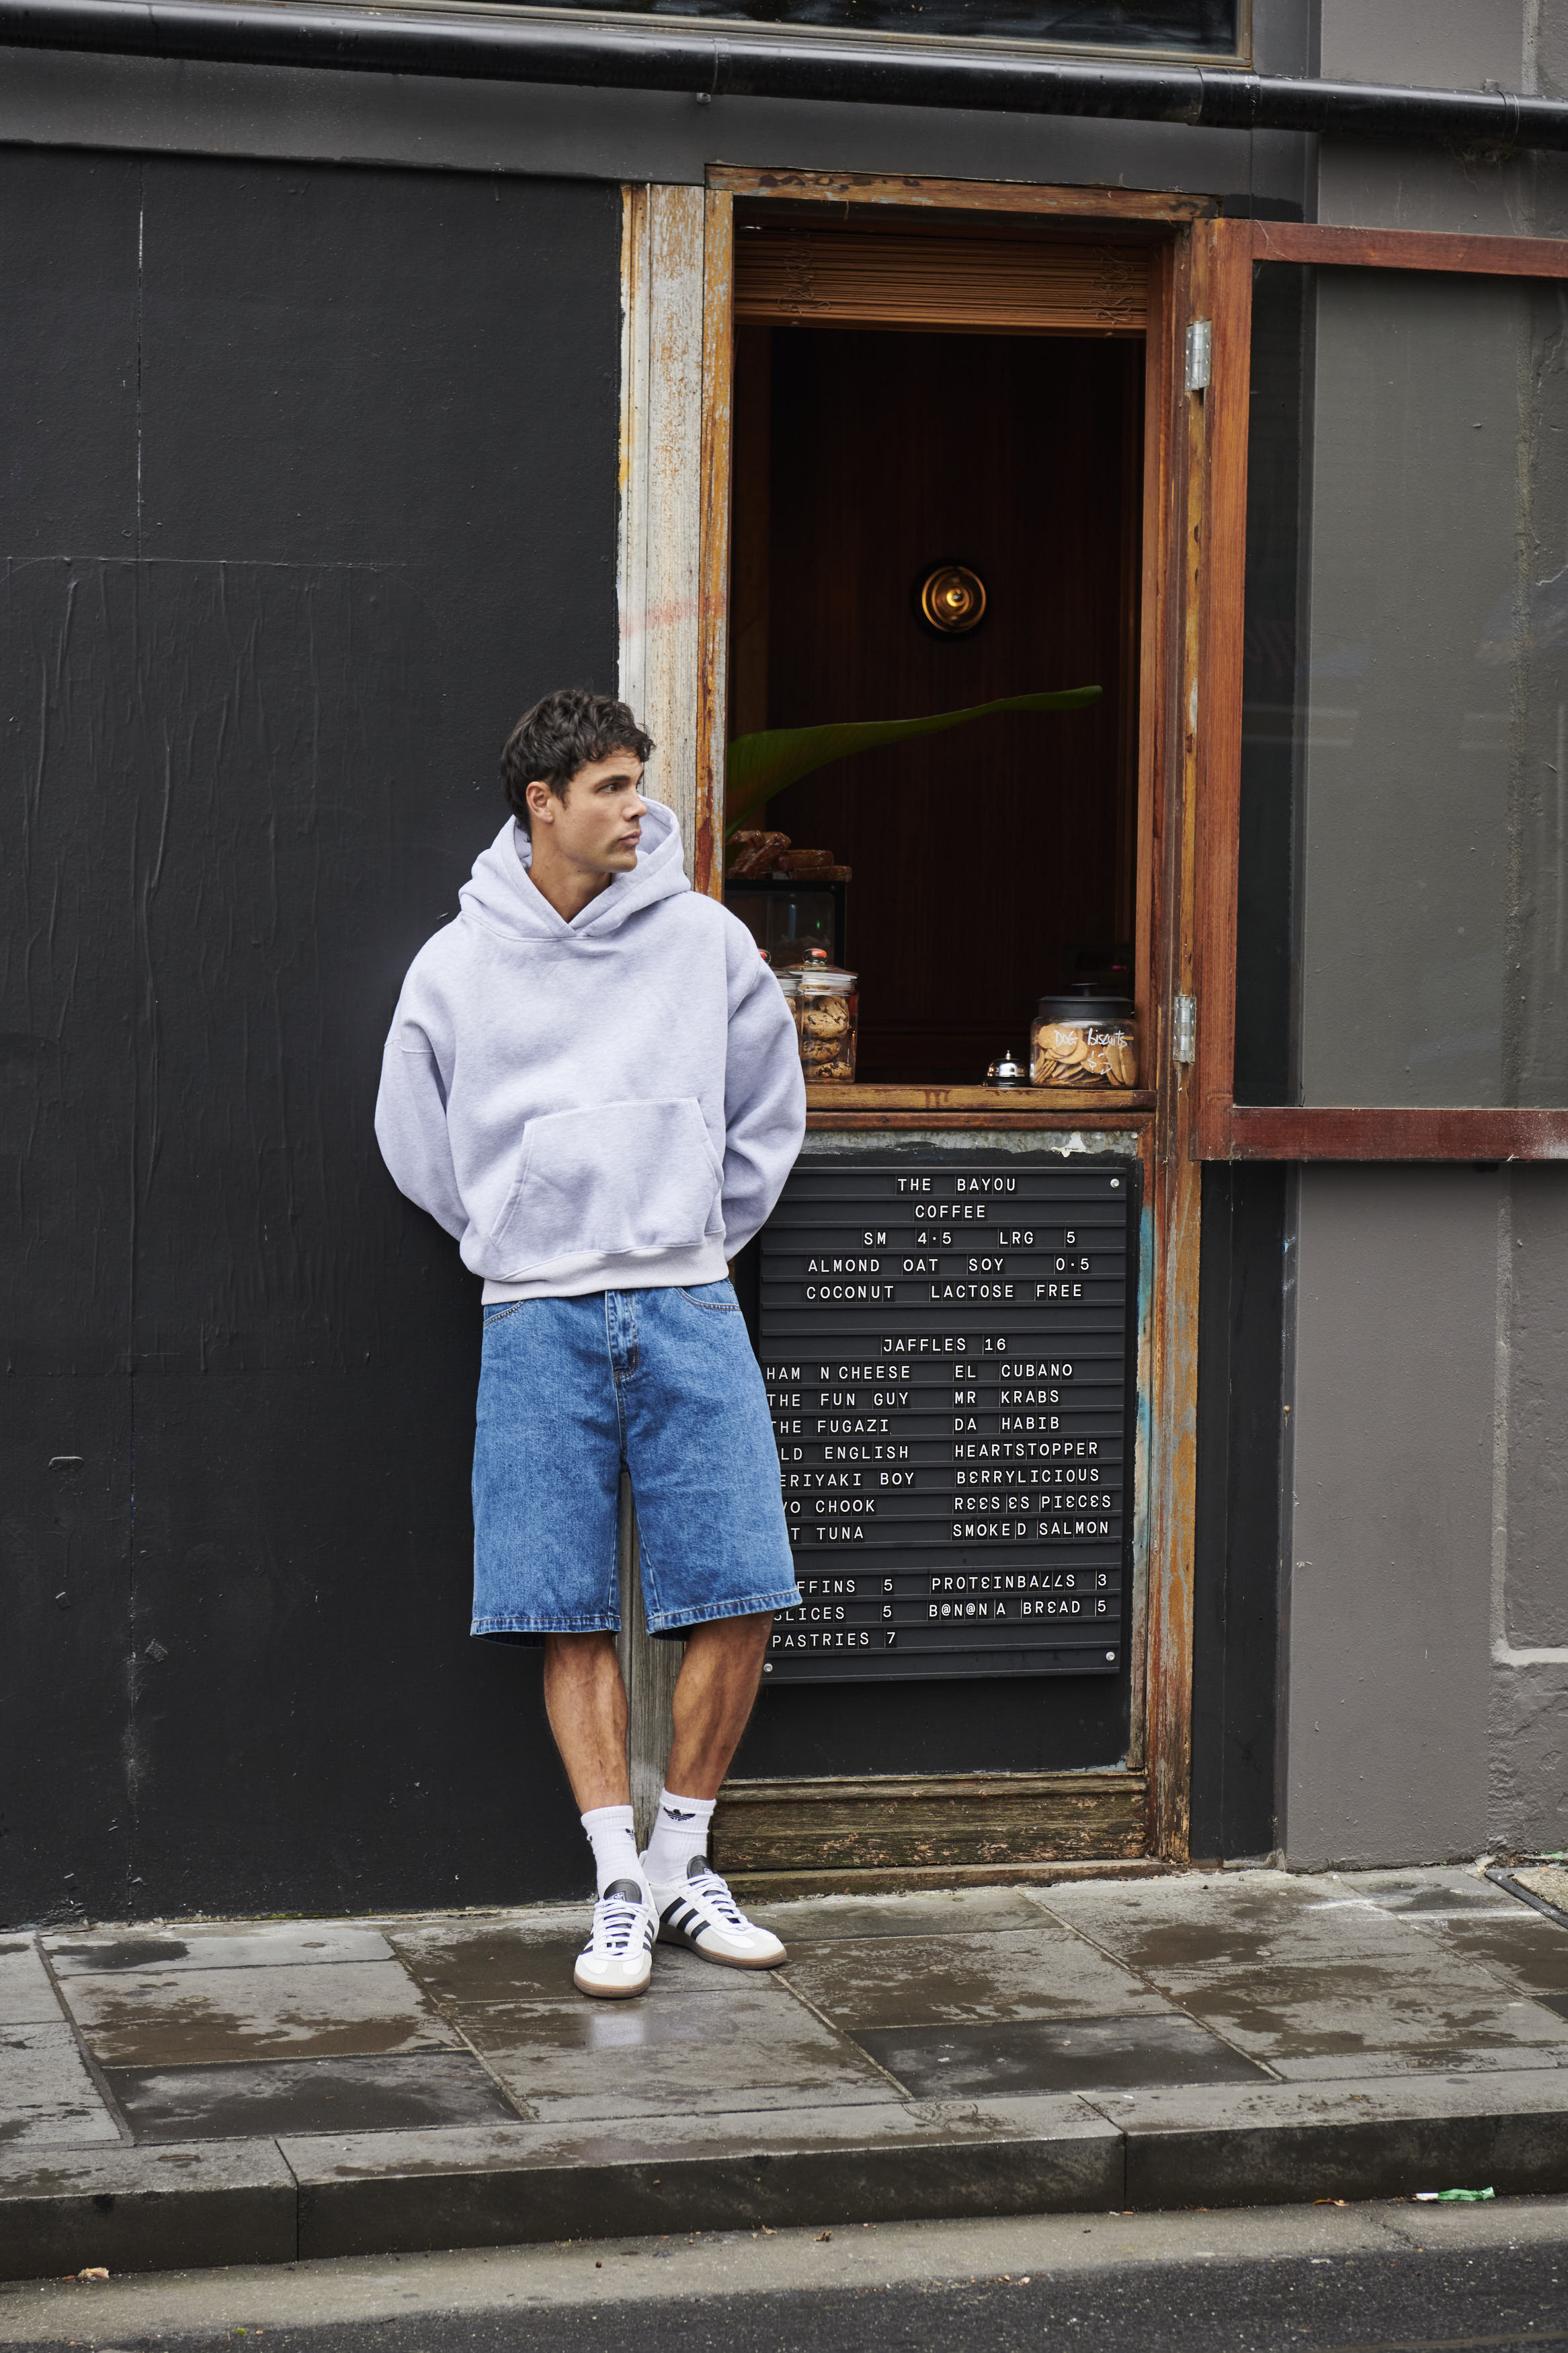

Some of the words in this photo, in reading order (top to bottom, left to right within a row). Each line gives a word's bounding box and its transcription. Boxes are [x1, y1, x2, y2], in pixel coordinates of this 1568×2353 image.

[1054, 1030, 1078, 1047] DOG
[897, 1178, 931, 1191] THE
[957, 1177, 1016, 1191] BAYOU
[915, 1205, 985, 1218] COFFEE
[864, 1232, 886, 1245] SM
[999, 1231, 1034, 1244] LRG
[1067, 1231, 1075, 1244] 5
[808, 1259, 880, 1273] ALMOND
[903, 1259, 938, 1272] OAT
[968, 1258, 1003, 1271] SOY
[807, 1285, 894, 1300] COCONUT
[932, 1284, 1014, 1298] LACTOSE
[1036, 1284, 1081, 1298] FREE
[883, 1337, 966, 1352] JAFFLES
[985, 1338, 1006, 1351] 16
[767, 1367, 800, 1380] HAM
[955, 1365, 976, 1378] EL
[1001, 1363, 1073, 1378] CUBANO
[766, 1394, 800, 1407] THE
[821, 1392, 855, 1406] FUN
[874, 1392, 909, 1406] GUY
[954, 1391, 976, 1404] MR
[1001, 1390, 1059, 1404] KRABS
[817, 1419, 889, 1433] FUGAZI
[954, 1417, 977, 1431] DA
[1001, 1417, 1059, 1430] HABIB
[781, 1447, 802, 1460] LD
[825, 1445, 908, 1460] ENGLISH
[955, 1441, 1098, 1458] HEARTSTOPPER
[780, 1473, 862, 1487] ERIYAKI
[880, 1472, 914, 1485] BOY
[815, 1499, 875, 1513] CHOOK
[816, 1526, 864, 1540] TUNA
[1039, 1521, 1108, 1536] SALMON
[796, 1579, 856, 1594] FFINS
[884, 1579, 893, 1591] 5
[1098, 1573, 1107, 1587] 3
[882, 1605, 892, 1618] 5
[1098, 1600, 1106, 1612] 5
[772, 1632, 870, 1648] PASTRIES
[886, 1632, 896, 1644] 7
